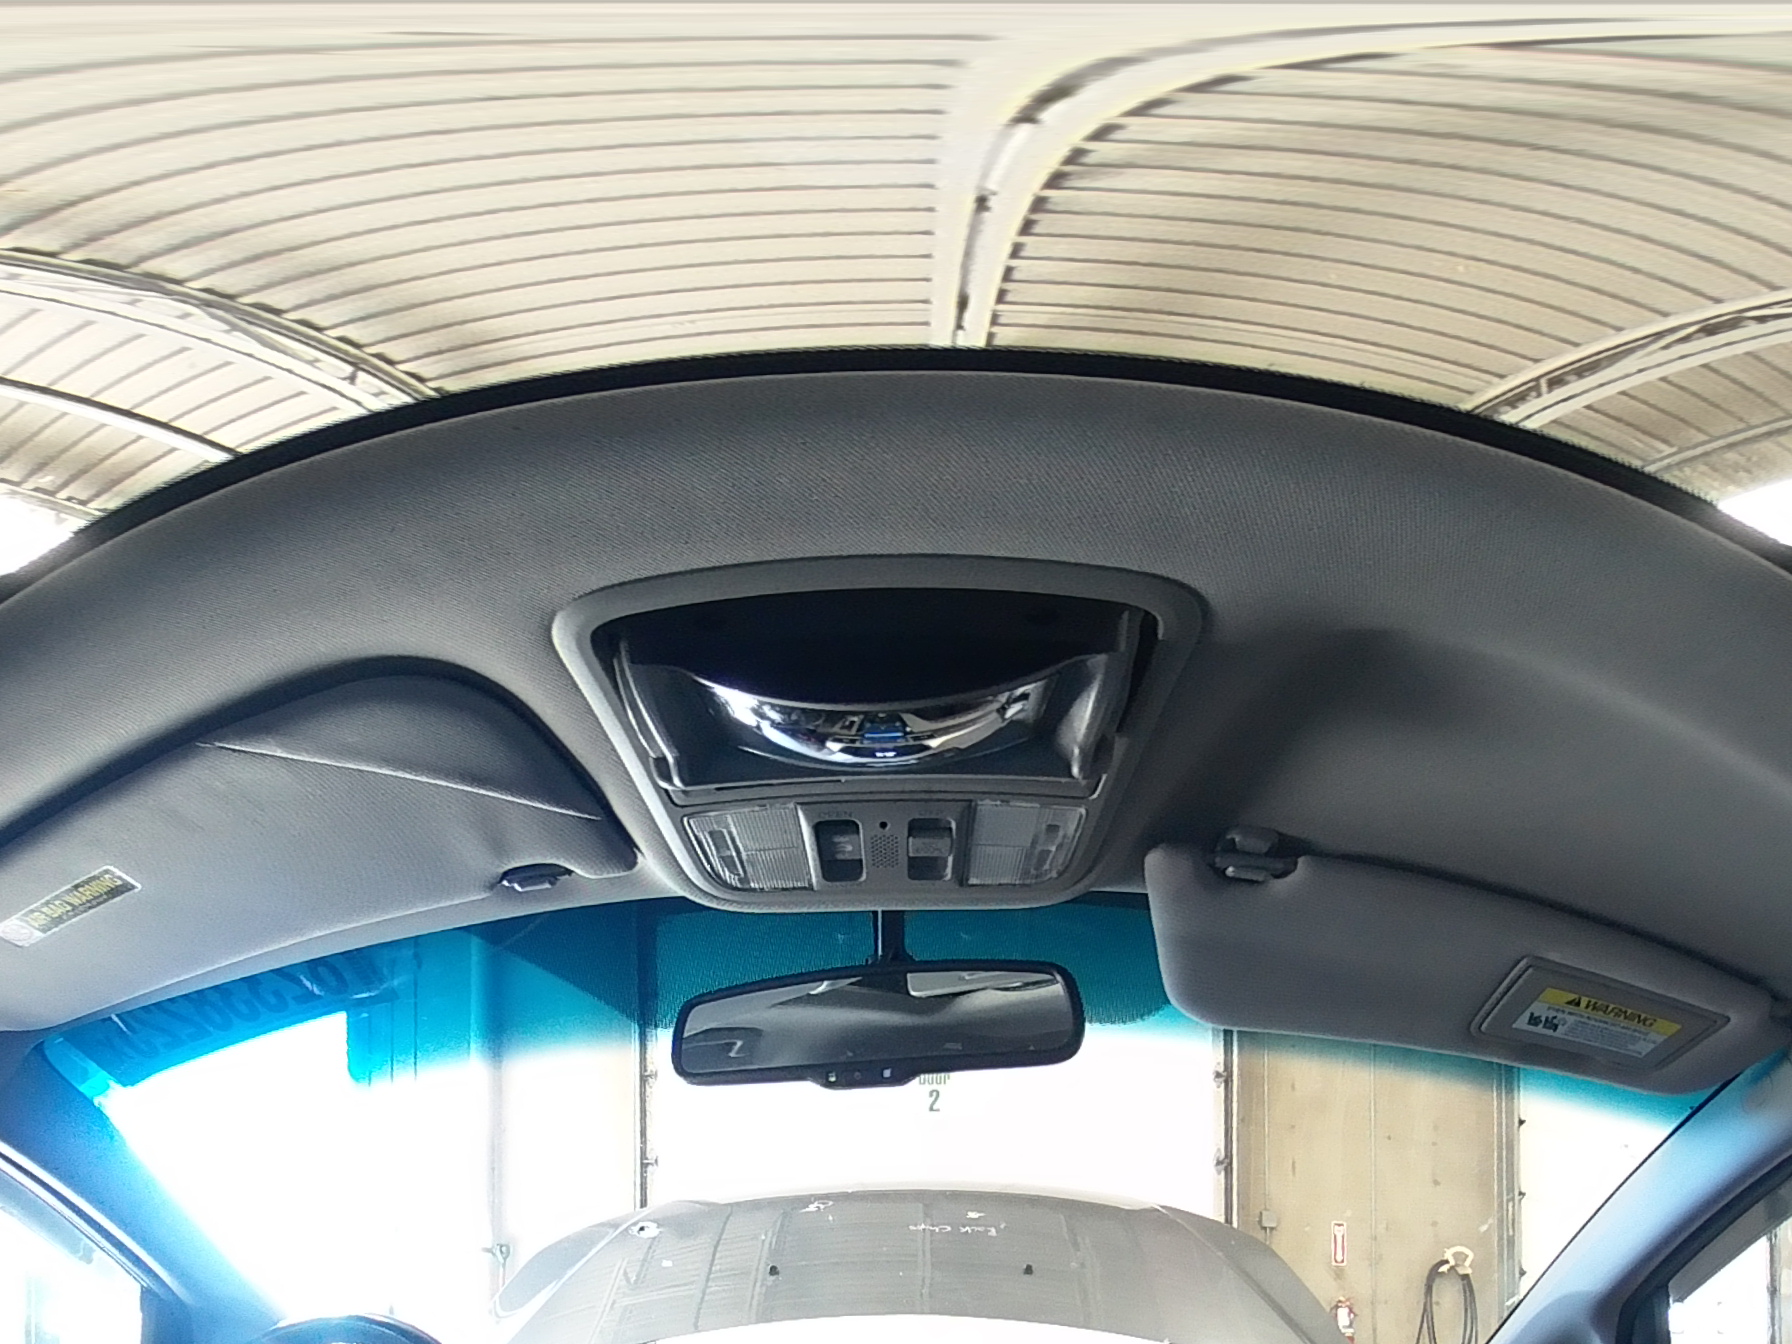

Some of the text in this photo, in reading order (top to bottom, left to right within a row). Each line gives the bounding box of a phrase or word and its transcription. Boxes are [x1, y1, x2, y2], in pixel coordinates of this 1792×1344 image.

[62, 873, 123, 906] WARNING
[1584, 999, 1657, 1028] WARNING
[929, 1089, 940, 1112] 2
